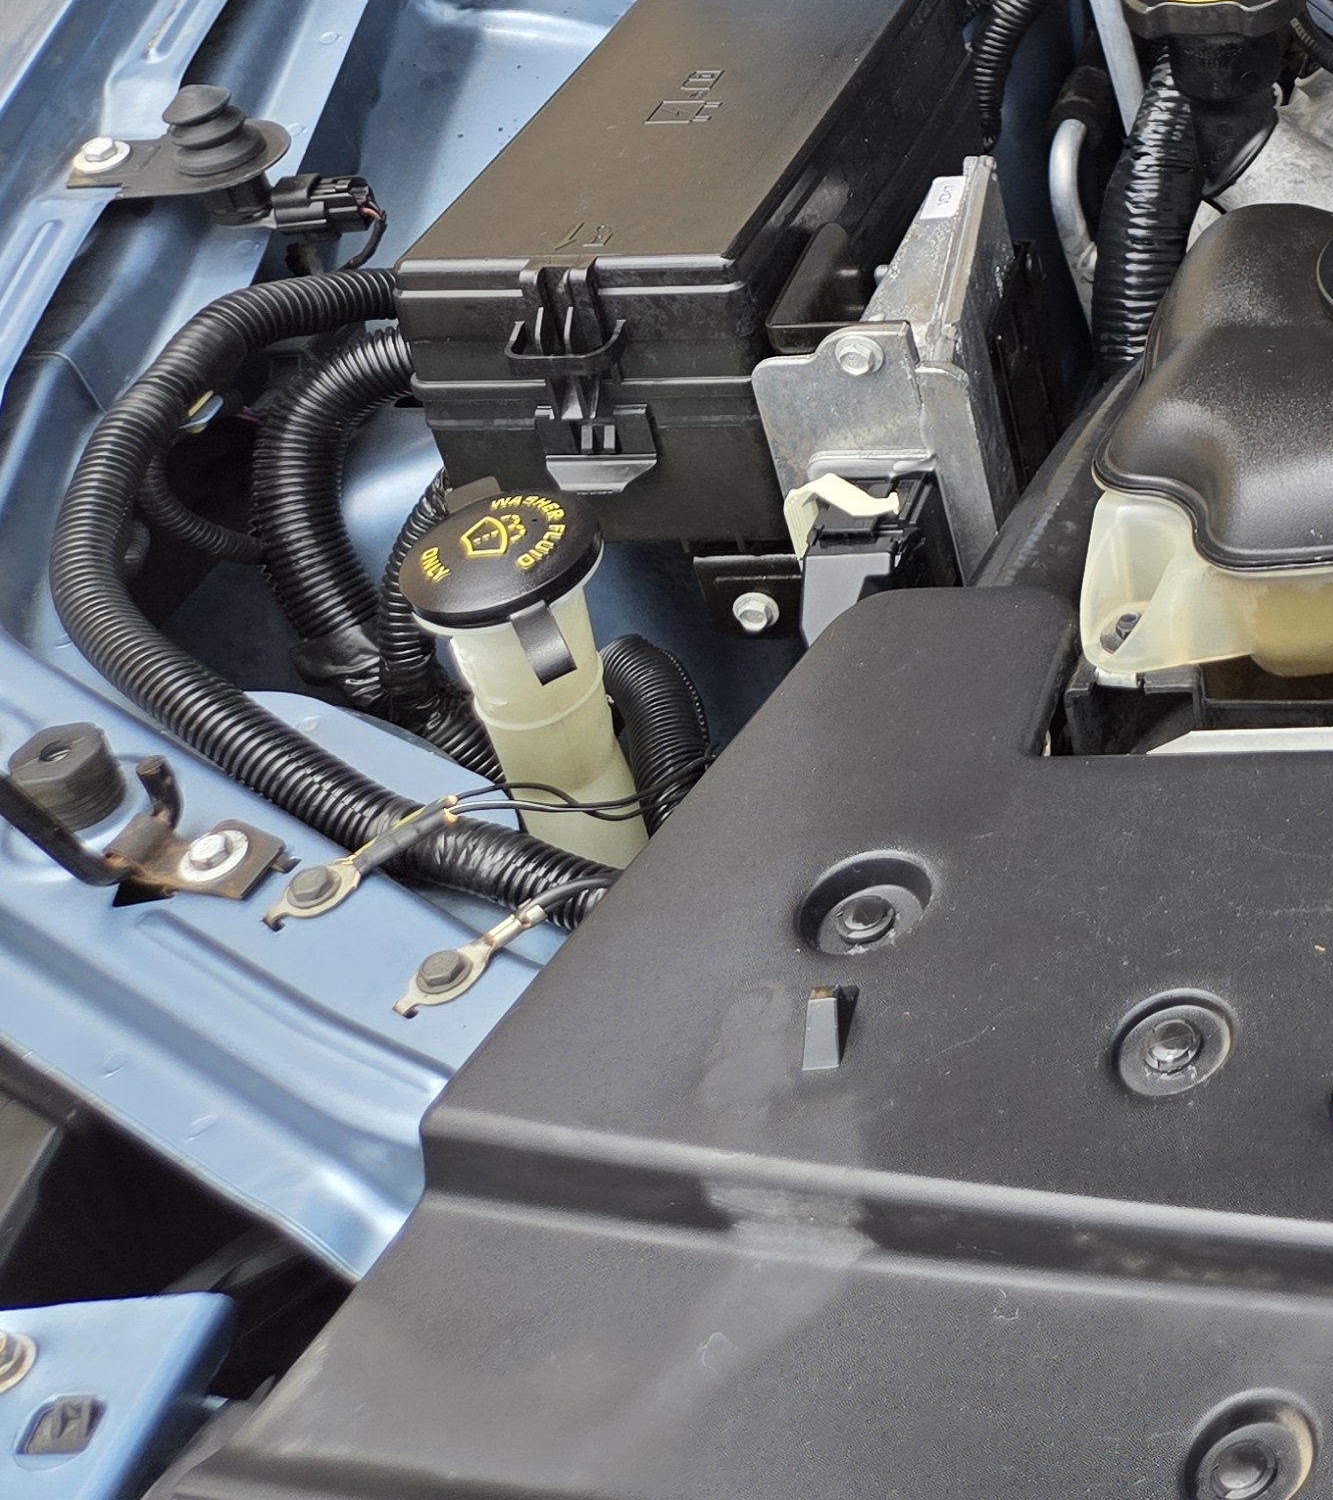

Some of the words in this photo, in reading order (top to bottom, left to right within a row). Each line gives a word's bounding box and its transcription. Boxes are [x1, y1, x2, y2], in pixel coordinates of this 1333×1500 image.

[491, 495, 565, 521] WASHER
[421, 546, 451, 581] ONLY
[516, 524, 566, 570] FLUID
